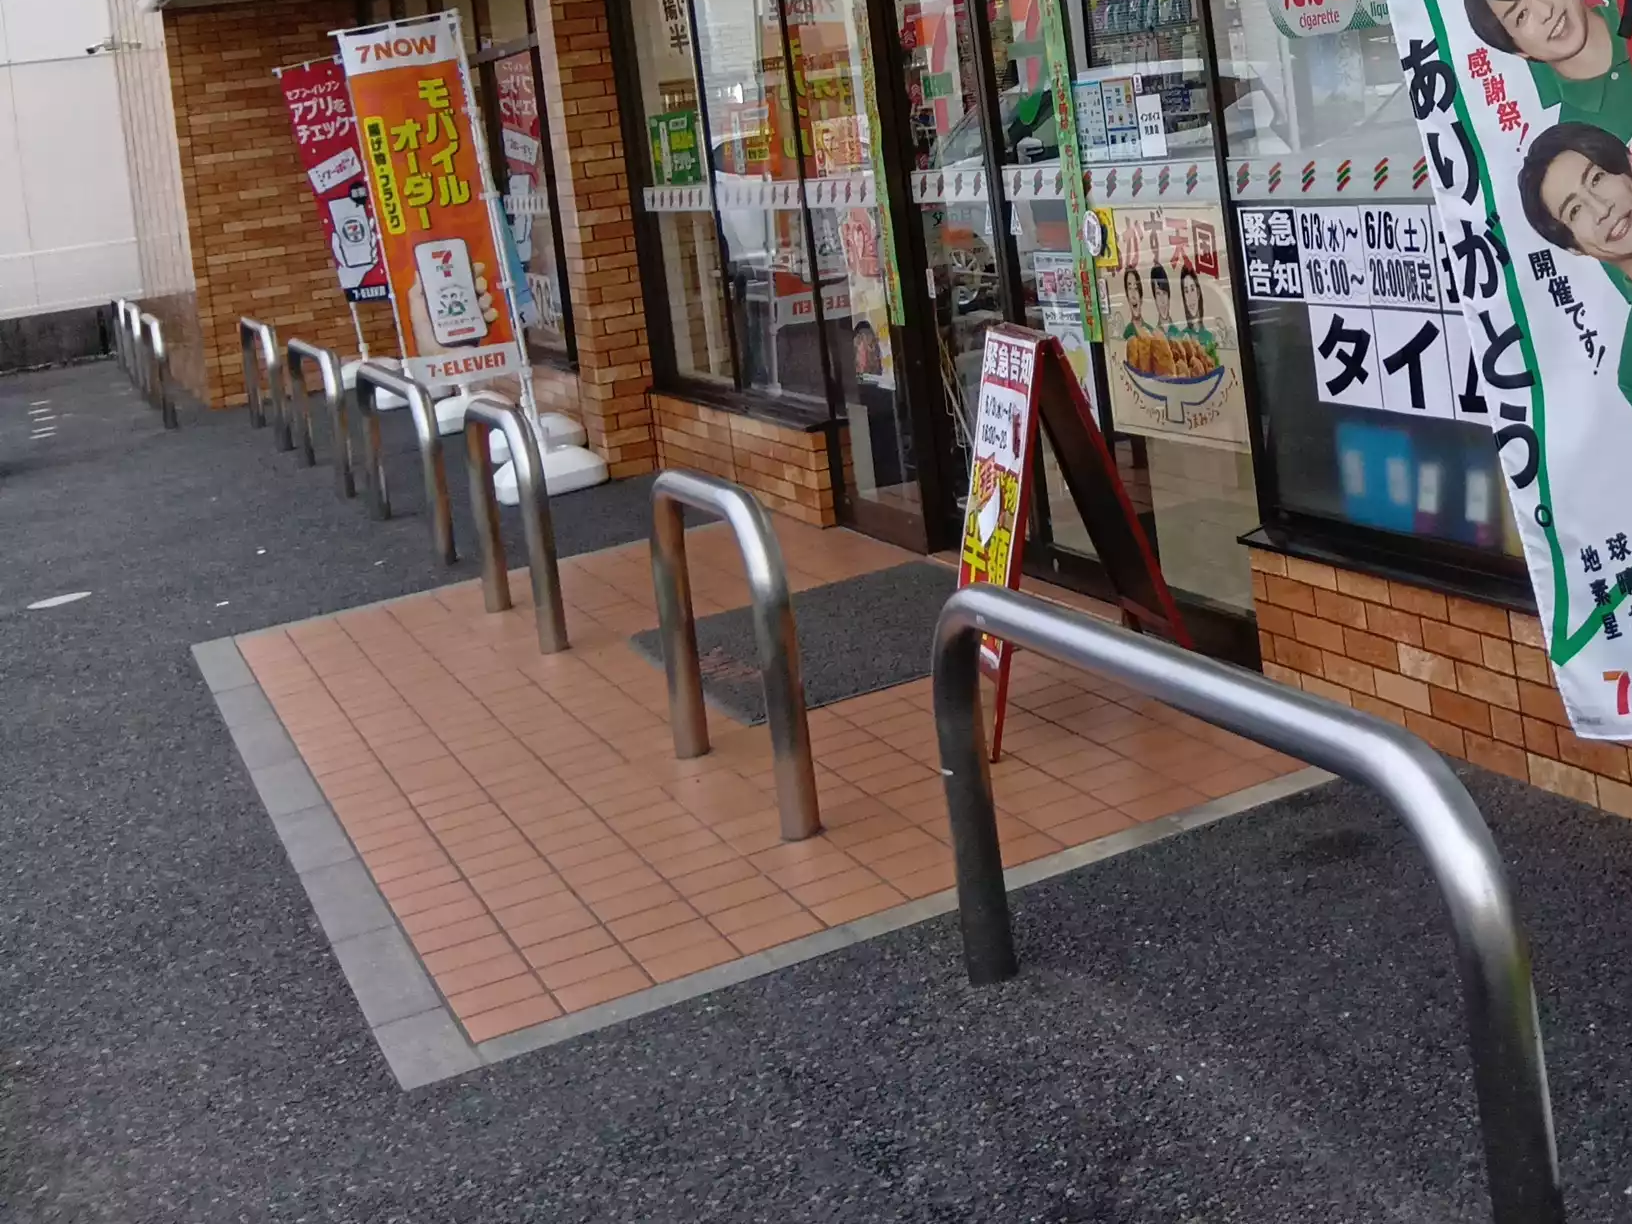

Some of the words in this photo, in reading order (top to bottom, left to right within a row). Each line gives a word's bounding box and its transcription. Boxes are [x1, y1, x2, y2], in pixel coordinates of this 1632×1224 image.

[1299, 7, 1340, 30] cigarette
[1369, 1, 1390, 19] liqu
[355, 34, 437, 65] 7NOW
[290, 94, 347, 125] アプリを
[417, 76, 471, 207] モバイル
[390, 117, 435, 231] オーダー
[1107, 205, 1220, 280] かず天国
[1242, 211, 1297, 247] 緊急
[1249, 259, 1301, 295] 告知
